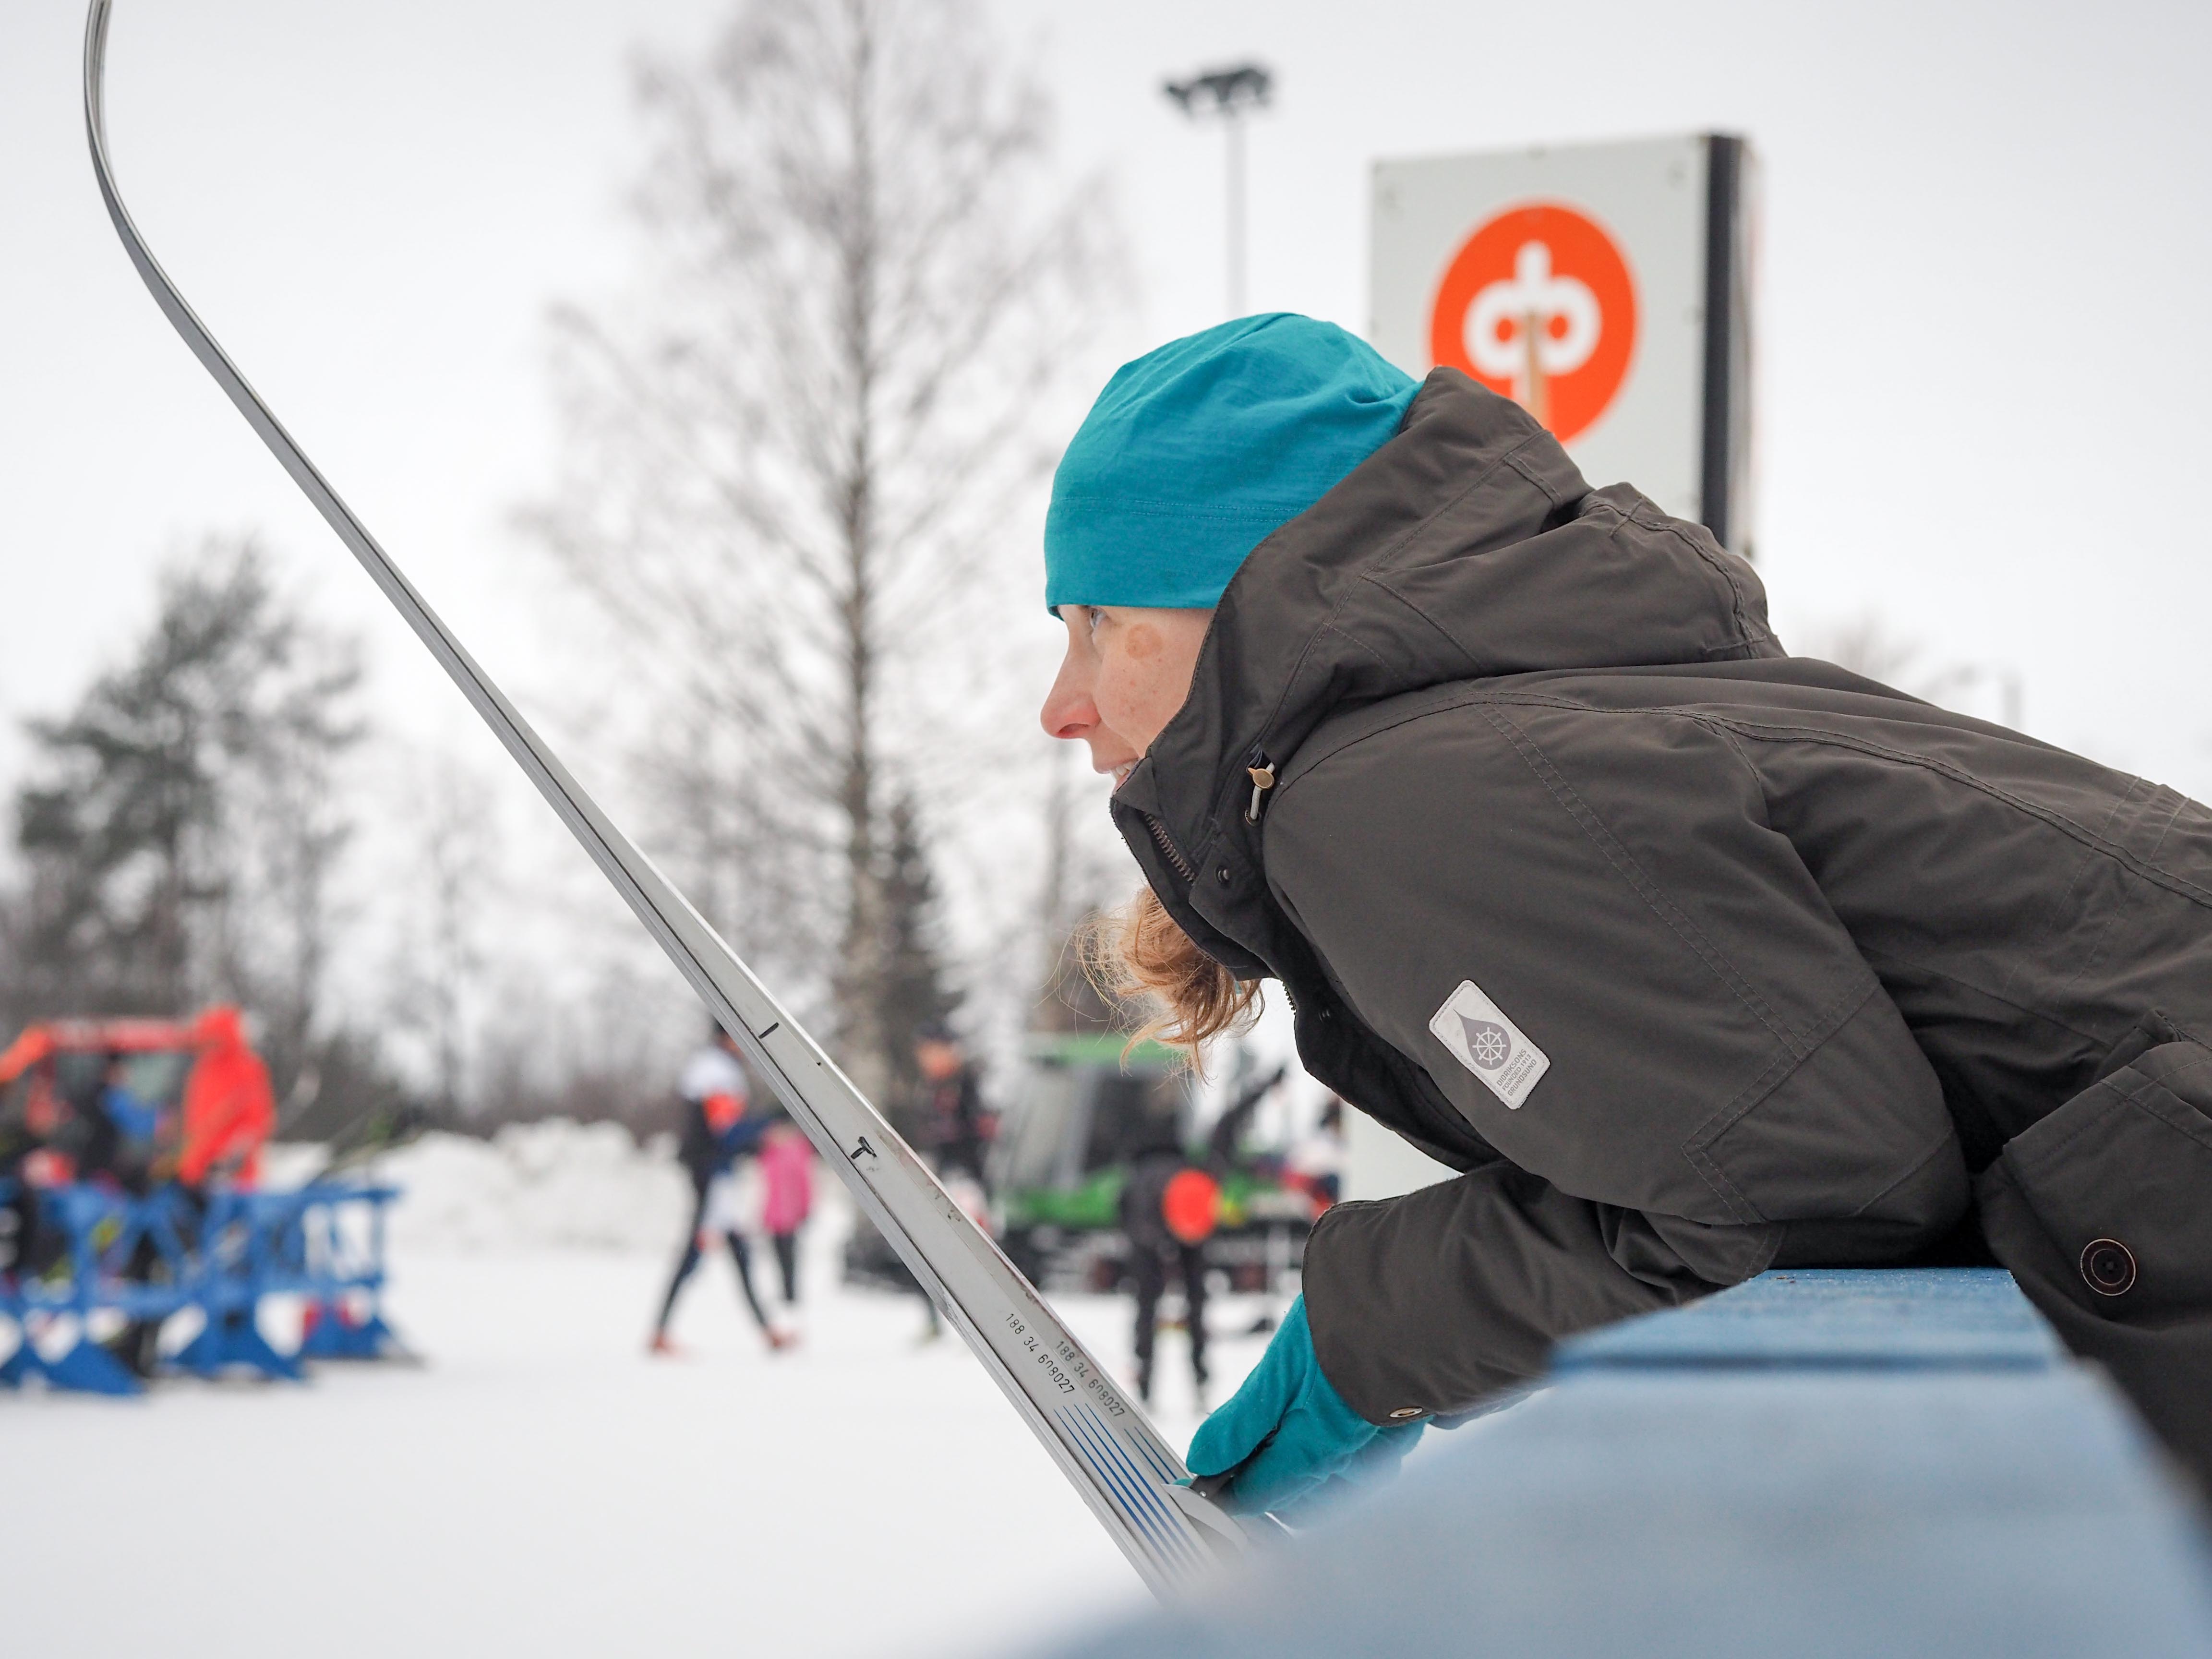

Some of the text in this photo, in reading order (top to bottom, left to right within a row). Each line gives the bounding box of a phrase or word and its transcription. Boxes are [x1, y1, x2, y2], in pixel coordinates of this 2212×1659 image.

[1496, 1048, 1527, 1086] DIDRIKSONS
[1502, 1054, 1532, 1091] FOUNDED 1913
[1507, 1059, 1537, 1096] GRUNDSUND
[1006, 1313, 1025, 1334] 188
[1023, 1336, 1039, 1352] 34
[1056, 1341, 1075, 1361] 188
[1074, 1362, 1090, 1378] 34
